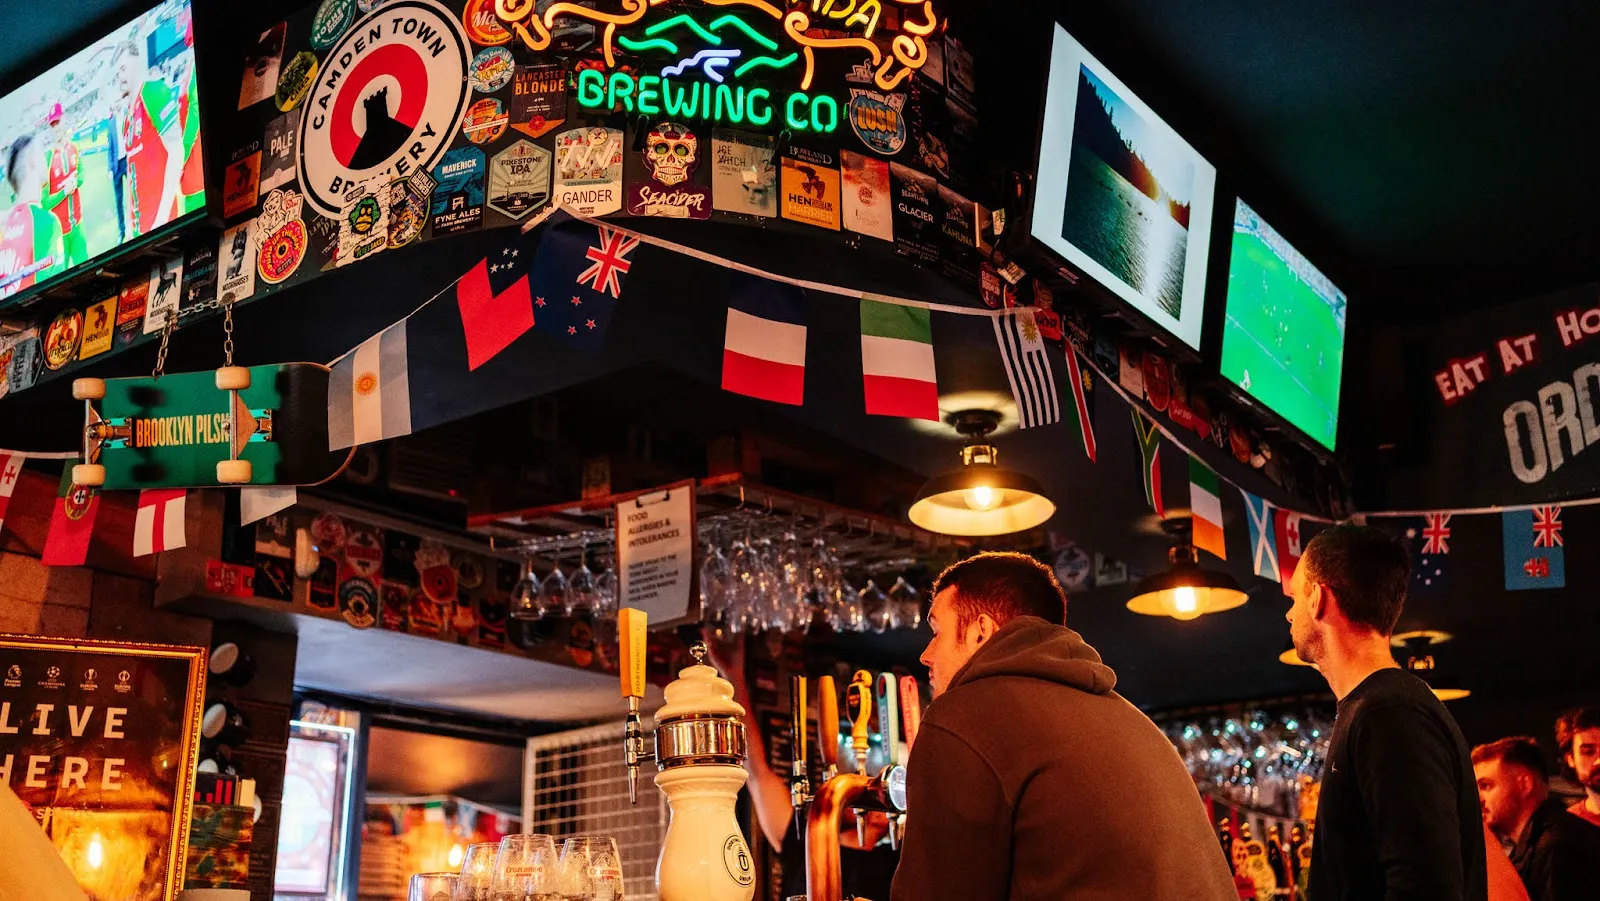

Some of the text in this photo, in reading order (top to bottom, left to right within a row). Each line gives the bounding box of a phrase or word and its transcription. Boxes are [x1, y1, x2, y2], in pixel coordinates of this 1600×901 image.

[314, 0, 352, 42] HOPHEA
[313, 24, 382, 130] CAMDEN
[392, 18, 446, 58] TOWN
[515, 70, 566, 82] LANCASTER
[514, 79, 565, 95] BLONDE
[577, 68, 838, 133] BREWING CO
[857, 106, 897, 133] LUSH
[271, 130, 293, 157] PALE
[717, 144, 732, 155] ICE
[329, 122, 437, 194] BRERY
[501, 156, 542, 166] PIKESTONE
[717, 155, 746, 167] WITCH
[789, 145, 833, 165] BOWLAND
[442, 158, 477, 175] MAVERICK
[510, 164, 531, 175] IPA
[562, 189, 613, 205] GANDER
[788, 193, 812, 206] HEN
[901, 189, 930, 206] BEARTOWN
[435, 207, 481, 224] FYNE ALES
[454, 217, 475, 225] BREWERY
[788, 203, 833, 222] HARRIER
[898, 202, 934, 223] GLACIER
[272, 235, 281, 245] UP
[281, 229, 293, 237] THE
[321, 220, 336, 237] IPA
[942, 223, 974, 247] KAHUNA
[1435, 356, 1485, 401] EAT
[1498, 333, 1537, 374] AT
[135, 414, 194, 448] BROOKLYN
[627, 511, 649, 523] FOOD
[628, 518, 671, 535] ALLERGIES &
[628, 528, 680, 548] INTOLERANCES
[0, 702, 128, 739] LIVE
